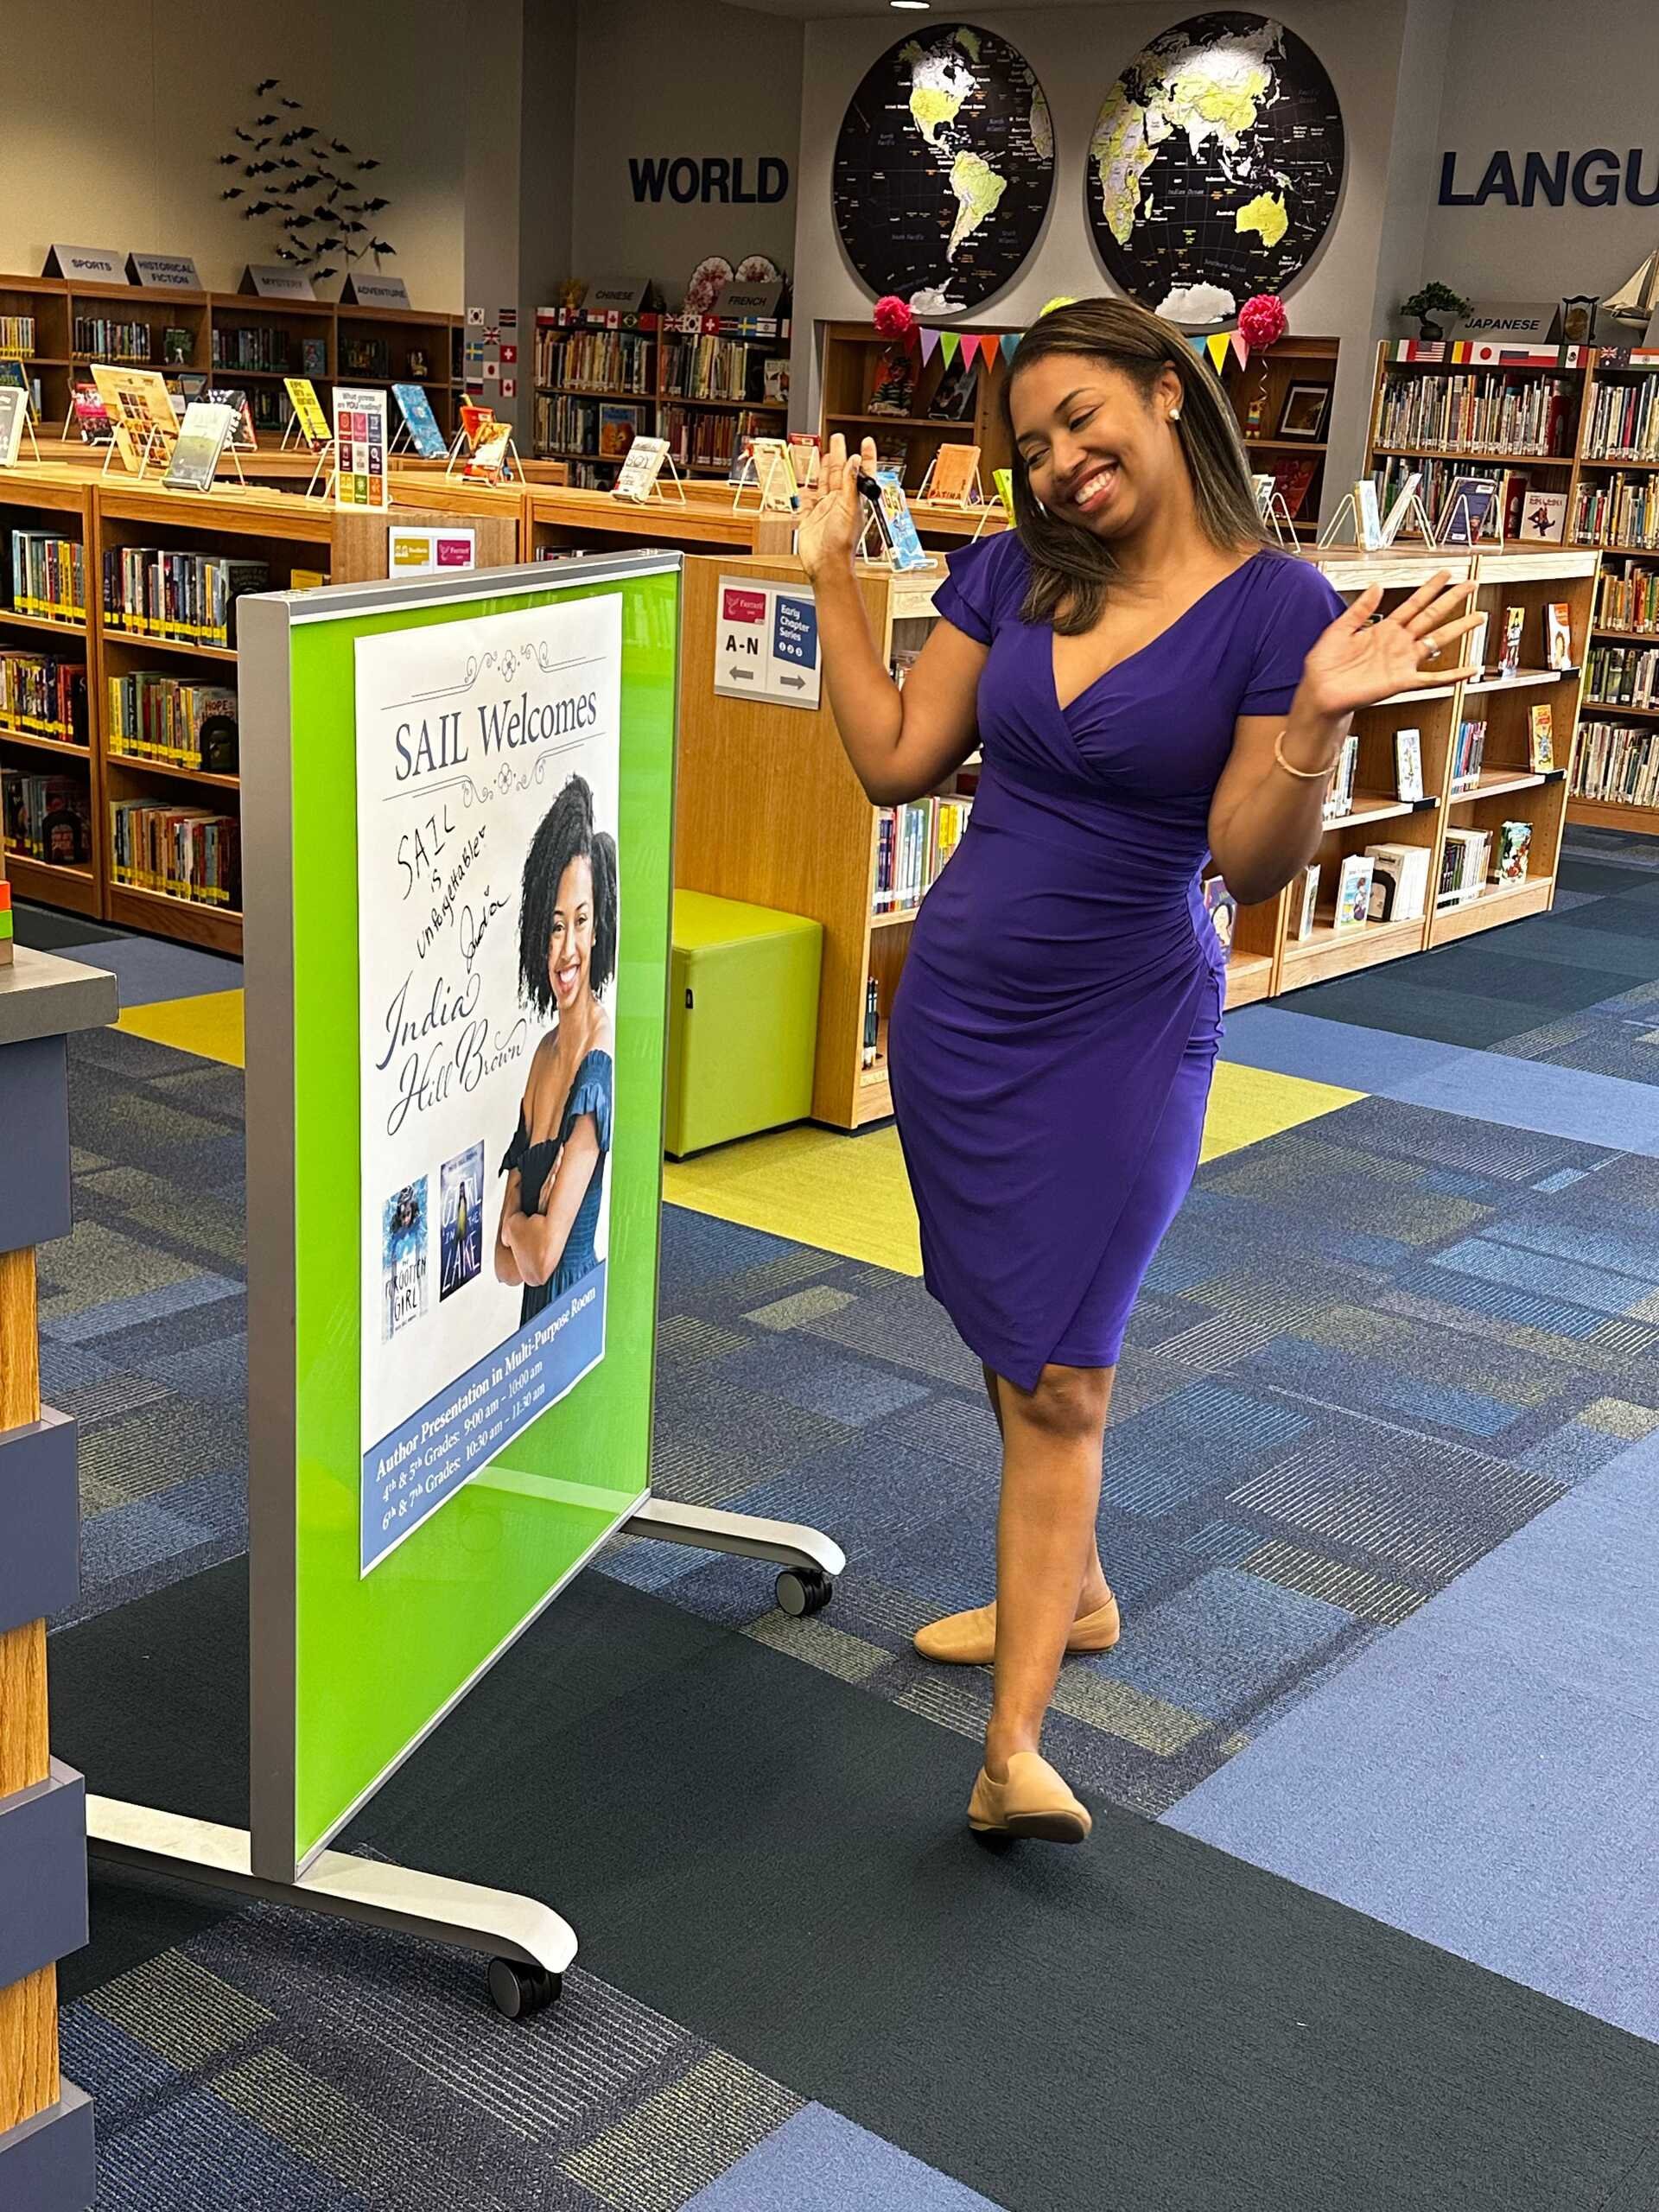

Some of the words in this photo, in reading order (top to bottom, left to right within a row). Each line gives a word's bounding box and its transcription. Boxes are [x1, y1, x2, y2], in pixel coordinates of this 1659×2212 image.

[628, 157, 789, 203] WORLD
[1438, 149, 1659, 207] LANGU
[72, 258, 112, 271] SPORTS
[137, 261, 194, 274] HISTORICAL
[151, 273, 189, 284] FICTION
[358, 286, 407, 298] ADVENTURE
[595, 290, 634, 301] CHINESE
[728, 296, 767, 306] FRENCH
[1465, 318, 1541, 330] JAPANESE
[780, 604, 800, 620] Early
[780, 615, 810, 633] Chapter
[779, 627, 802, 641] Series
[395, 711, 469, 781] SAIL
[477, 691, 597, 756] Welcomes
[397, 804, 456, 900] SAIL
[376, 969, 481, 1071] India
[387, 1041, 454, 1136] Hill
[455, 1018, 527, 1092] Brown
[442, 1173, 482, 1228] GIRL
[442, 1230, 480, 1294] LAKE
[394, 1287, 417, 1322] GIRL
[376, 1433, 419, 1483] Author
[420, 1379, 490, 1445] Presentation
[492, 1368, 503, 1387] in
[505, 1309, 570, 1376] Multi-Purpose
[570, 1287, 596, 1318] Room
[382, 1478, 397, 1503] 4th
[398, 1471, 408, 1490] &
[410, 1457, 423, 1481] 5th
[424, 1431, 461, 1466] Grades:
[464, 1408, 484, 1436] 9:00
[485, 1398, 499, 1419] am
[508, 1370, 529, 1398] 10:00
[529, 1361, 543, 1380] am
[382, 1505, 397, 1530] 6th
[398, 1499, 408, 1517] &
[409, 1484, 423, 1508] 7th
[425, 1457, 461, 1494] Grades:
[466, 1433, 488, 1461] 10:30
[489, 1421, 503, 1440] am
[512, 1394, 531, 1420] 11:30
[532, 1382, 545, 1402] am
